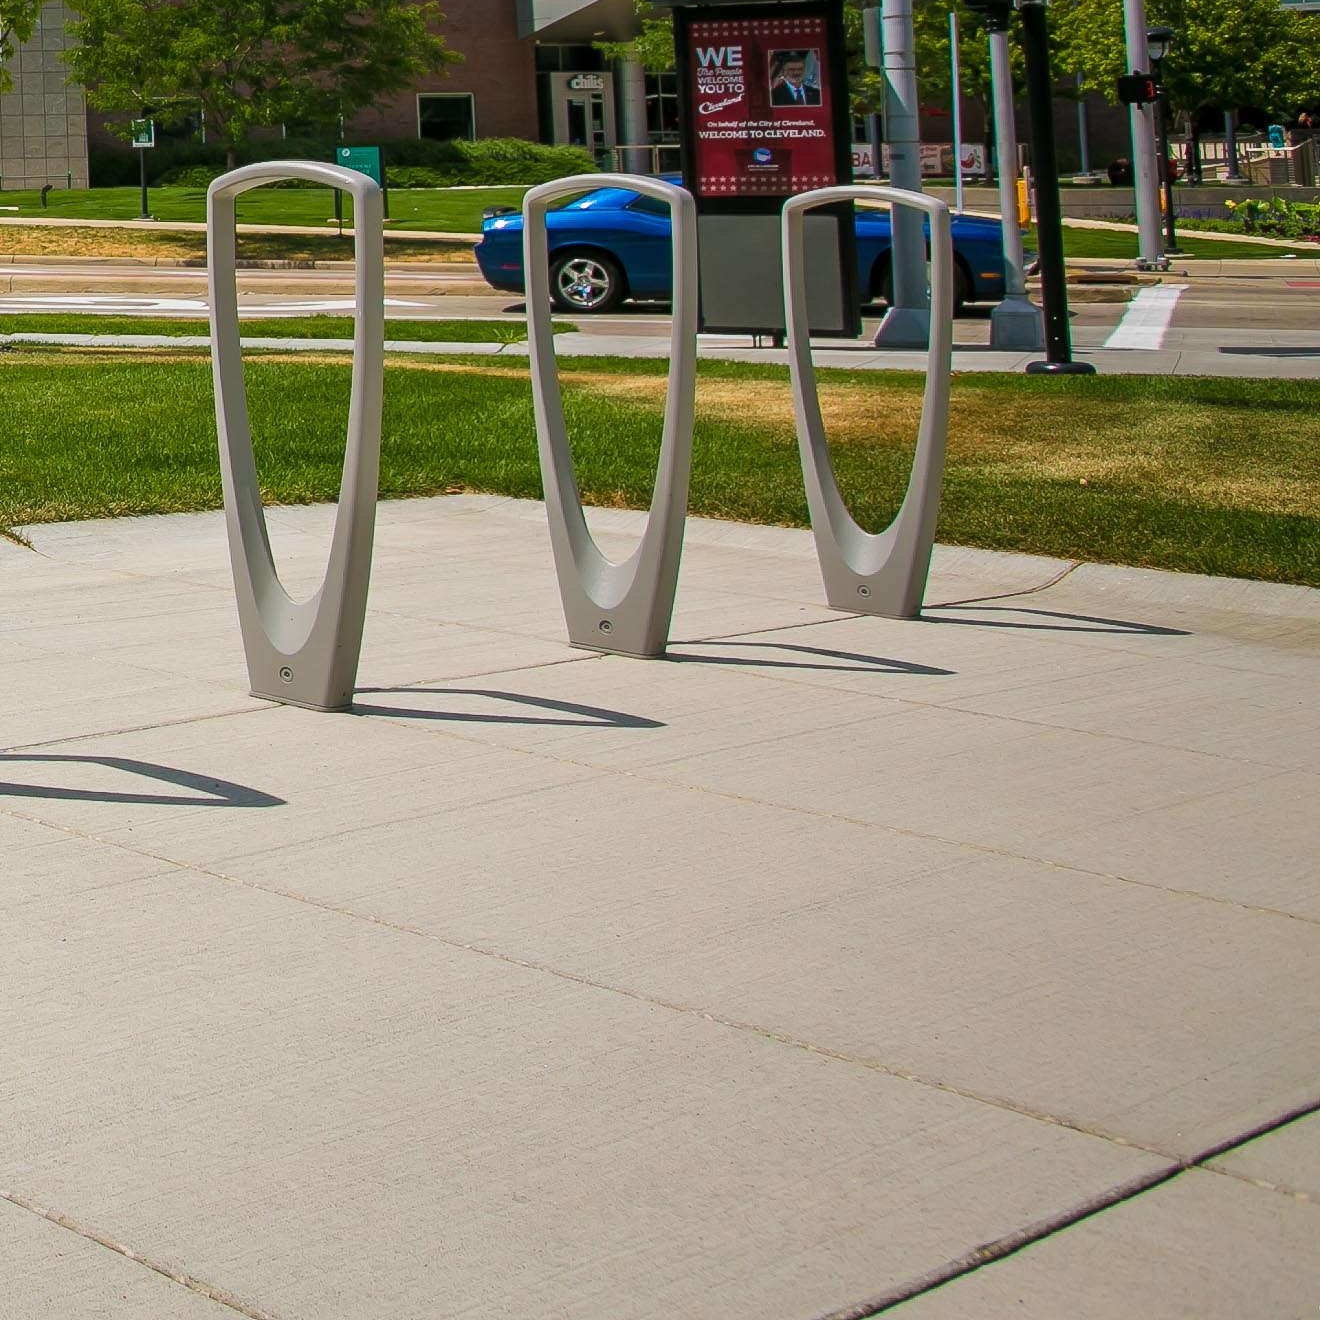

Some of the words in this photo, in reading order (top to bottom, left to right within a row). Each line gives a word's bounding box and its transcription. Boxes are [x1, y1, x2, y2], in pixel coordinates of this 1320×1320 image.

[695, 46, 743, 67] WE
[697, 76, 745, 84] WELCOME
[698, 84, 725, 94] YOU
[727, 83, 745, 93] TO
[698, 93, 745, 114] Cleveland
[698, 130, 748, 139] WELCOME
[749, 130, 763, 138] TO
